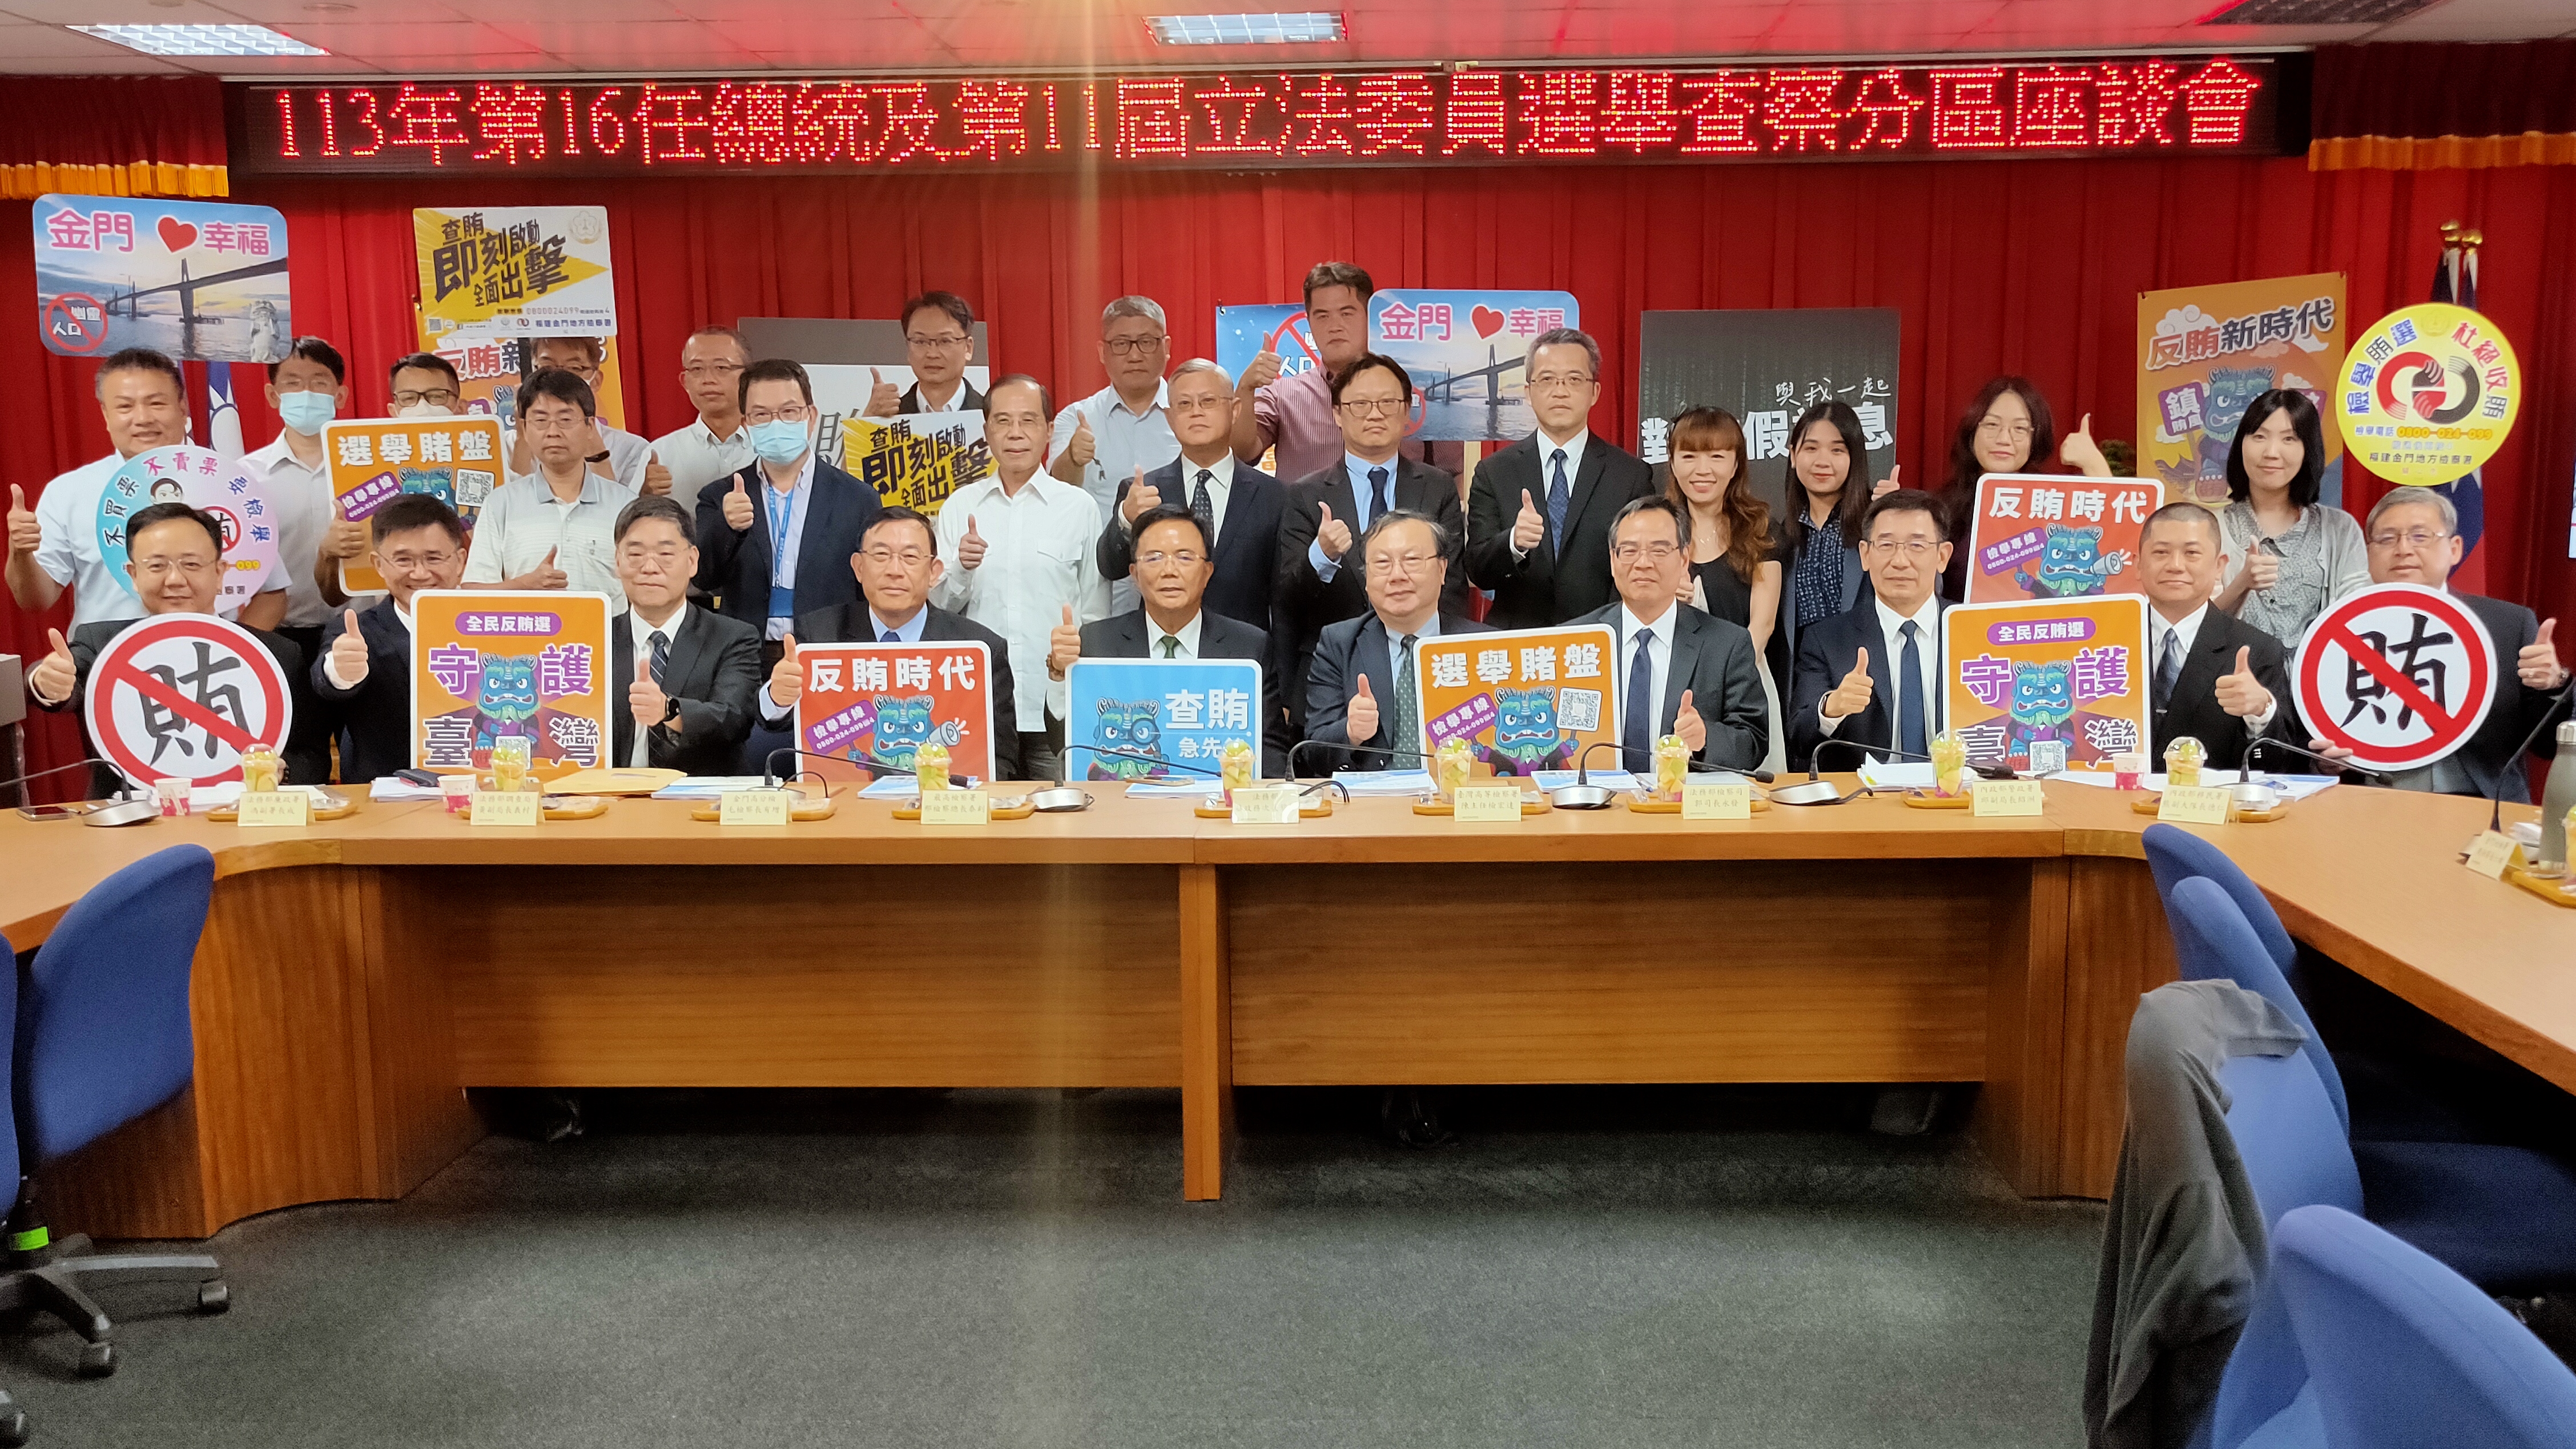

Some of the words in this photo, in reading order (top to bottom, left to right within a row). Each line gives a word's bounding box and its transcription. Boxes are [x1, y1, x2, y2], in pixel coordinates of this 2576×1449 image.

[278, 58, 2261, 164] 113年第16任總統及第11屆立法委員選舉查察分區座談會
[47, 208, 134, 252] 金門
[203, 222, 270, 255] 幸福
[442, 212, 484, 245] 查賄
[433, 219, 540, 303] 即刻啟動
[473, 234, 569, 307] 全面出擊
[53, 321, 82, 336] 人口
[1380, 302, 1452, 341] 金門
[1508, 308, 1565, 336] 幸福
[2147, 297, 2332, 369] 反賄新時代
[434, 341, 520, 376] 反賄新
[2347, 319, 2417, 414] 檢舉賄選
[2452, 322, 2507, 419] 杜絕收賄
[1776, 377, 1891, 407] 與我一起
[337, 430, 493, 466] 選舉賭盤
[870, 419, 911, 453] 查賄
[1641, 401, 1893, 464] 對假息
[2397, 426, 2492, 440] 0800-024-099
[143, 452, 218, 476] 不賣票
[862, 422, 966, 494] 即刻啟動
[104, 476, 140, 546] 不買票
[1989, 488, 2147, 524] 反賄時代
[466, 615, 551, 633] 全民反賄選
[1998, 621, 2084, 642] 全民反賄選
[809, 655, 976, 693] 反賄時代
[1431, 643, 1601, 689] 選舉賭盤
[2340, 613, 2453, 733] 賄
[139, 642, 251, 766] 賄
[1165, 687, 1250, 730] 查賄
[1178, 737, 1246, 759] 急先
